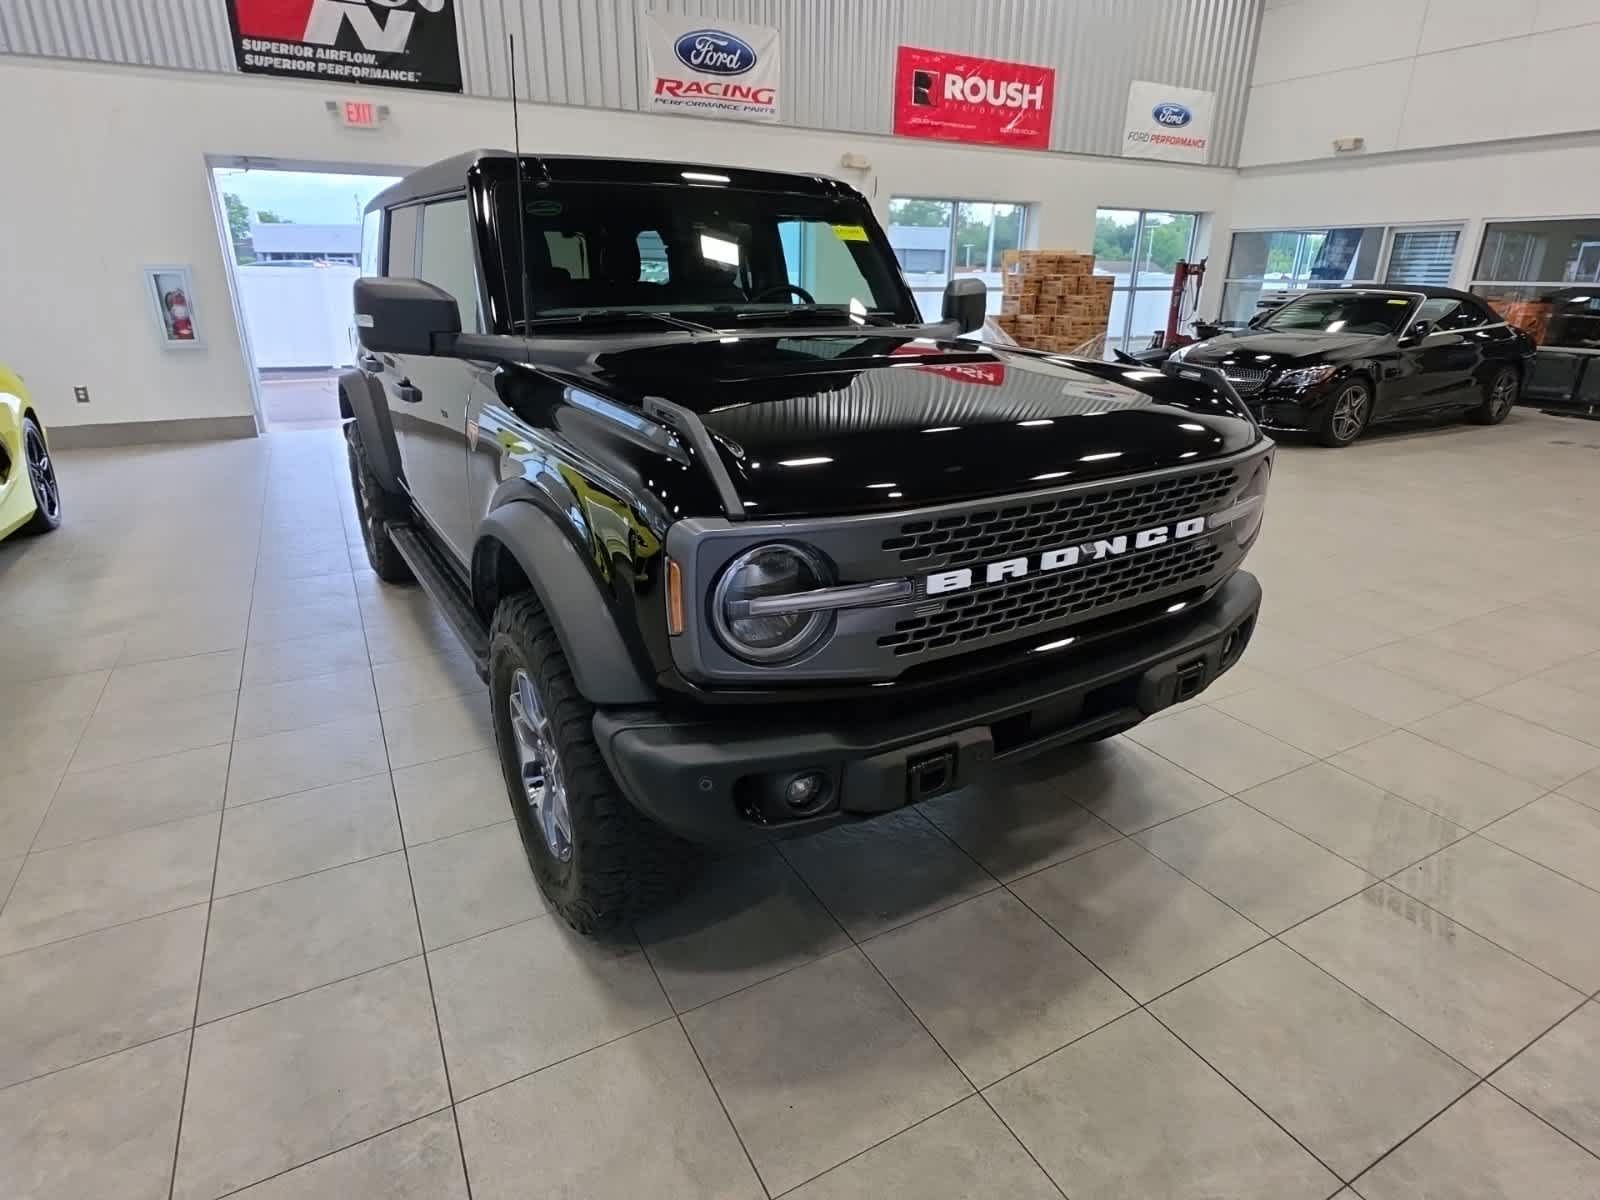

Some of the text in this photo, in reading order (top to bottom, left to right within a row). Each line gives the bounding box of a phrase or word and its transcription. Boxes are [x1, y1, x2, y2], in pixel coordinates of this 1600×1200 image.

[242, 38, 378, 65] SUPERIOR AIRFLOW.
[244, 54, 316, 73] SUPERIOR
[691, 36, 741, 69] Ford
[655, 77, 776, 105] RACING
[944, 73, 1043, 110] ROUSH
[345, 102, 373, 124] EXIT
[654, 97, 776, 114] PERFORMANCE PARTS
[1159, 106, 1186, 124] Ford
[1128, 131, 1207, 148] FORD PERFORMANCE
[926, 517, 1205, 595] BRONCO
